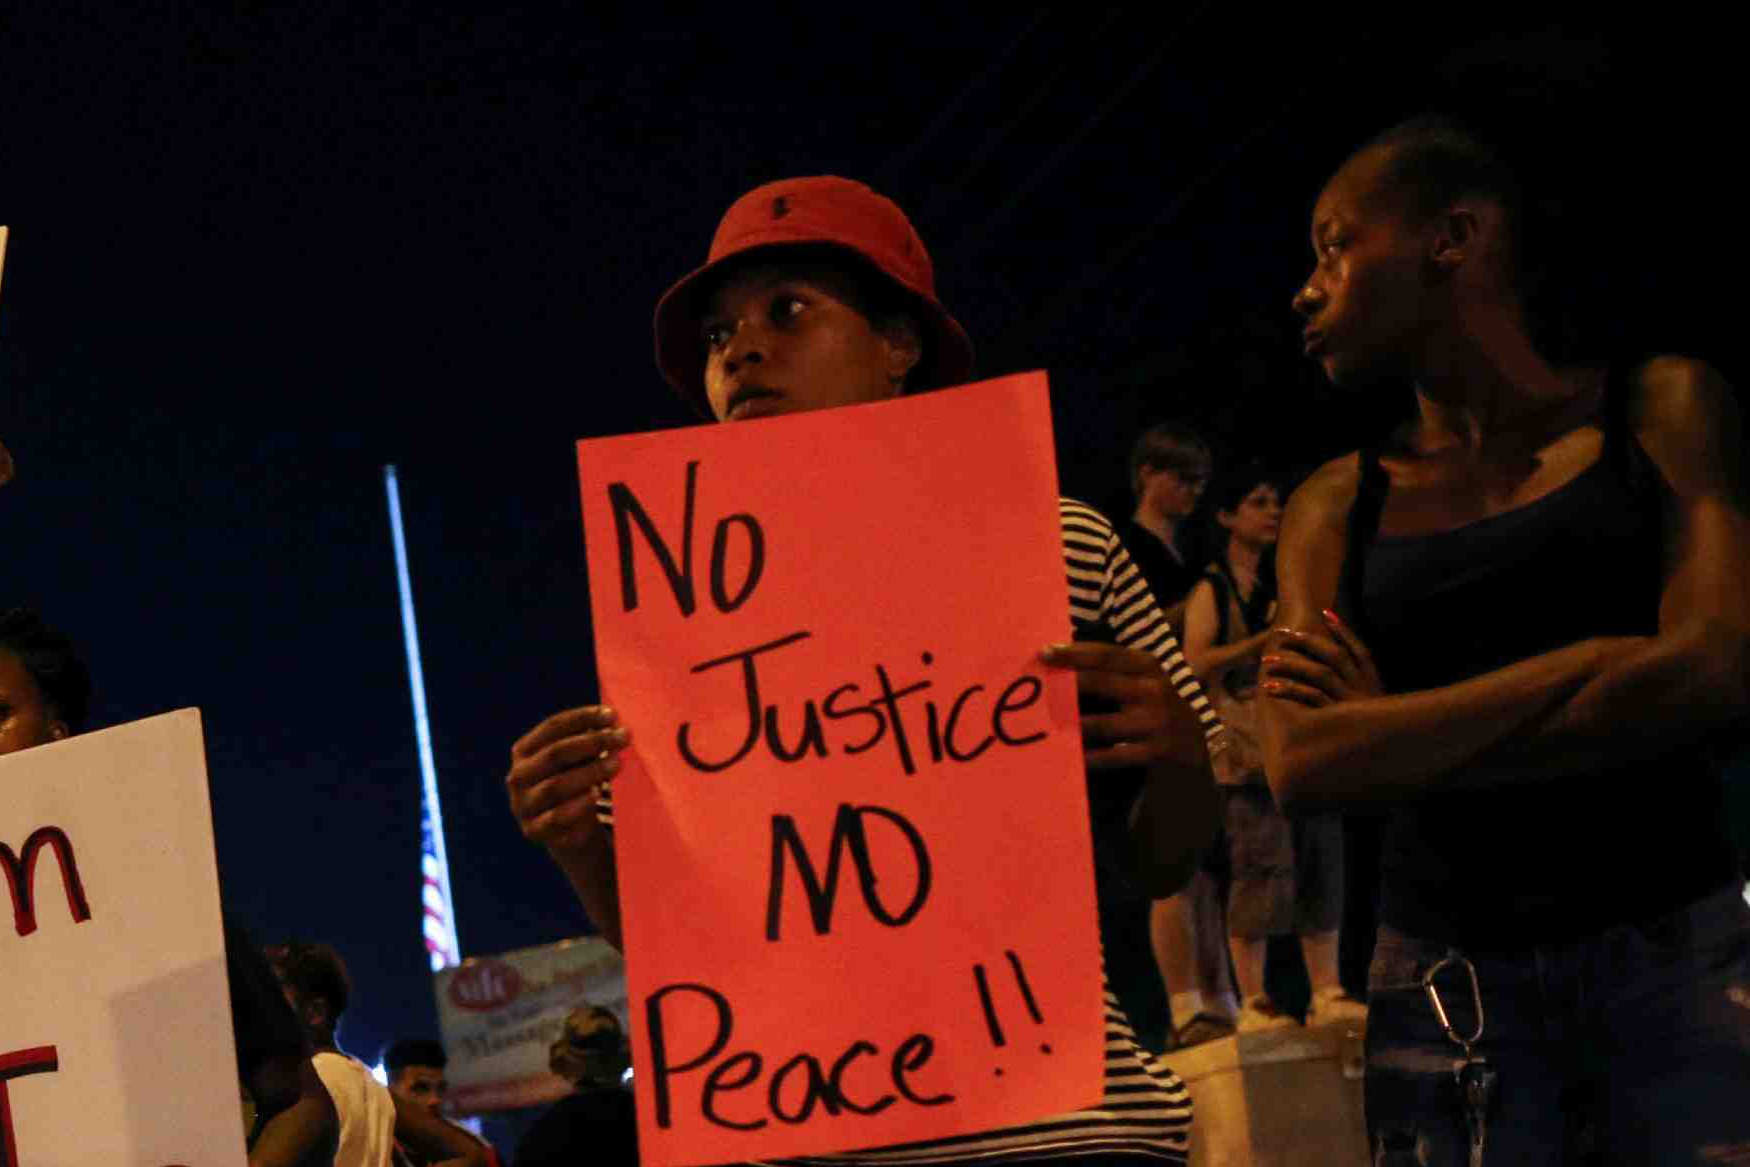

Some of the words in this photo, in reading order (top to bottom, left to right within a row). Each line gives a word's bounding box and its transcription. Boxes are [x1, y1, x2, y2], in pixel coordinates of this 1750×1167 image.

[606, 460, 767, 620] No
[677, 631, 1049, 776] Justice
[766, 803, 933, 942] NO
